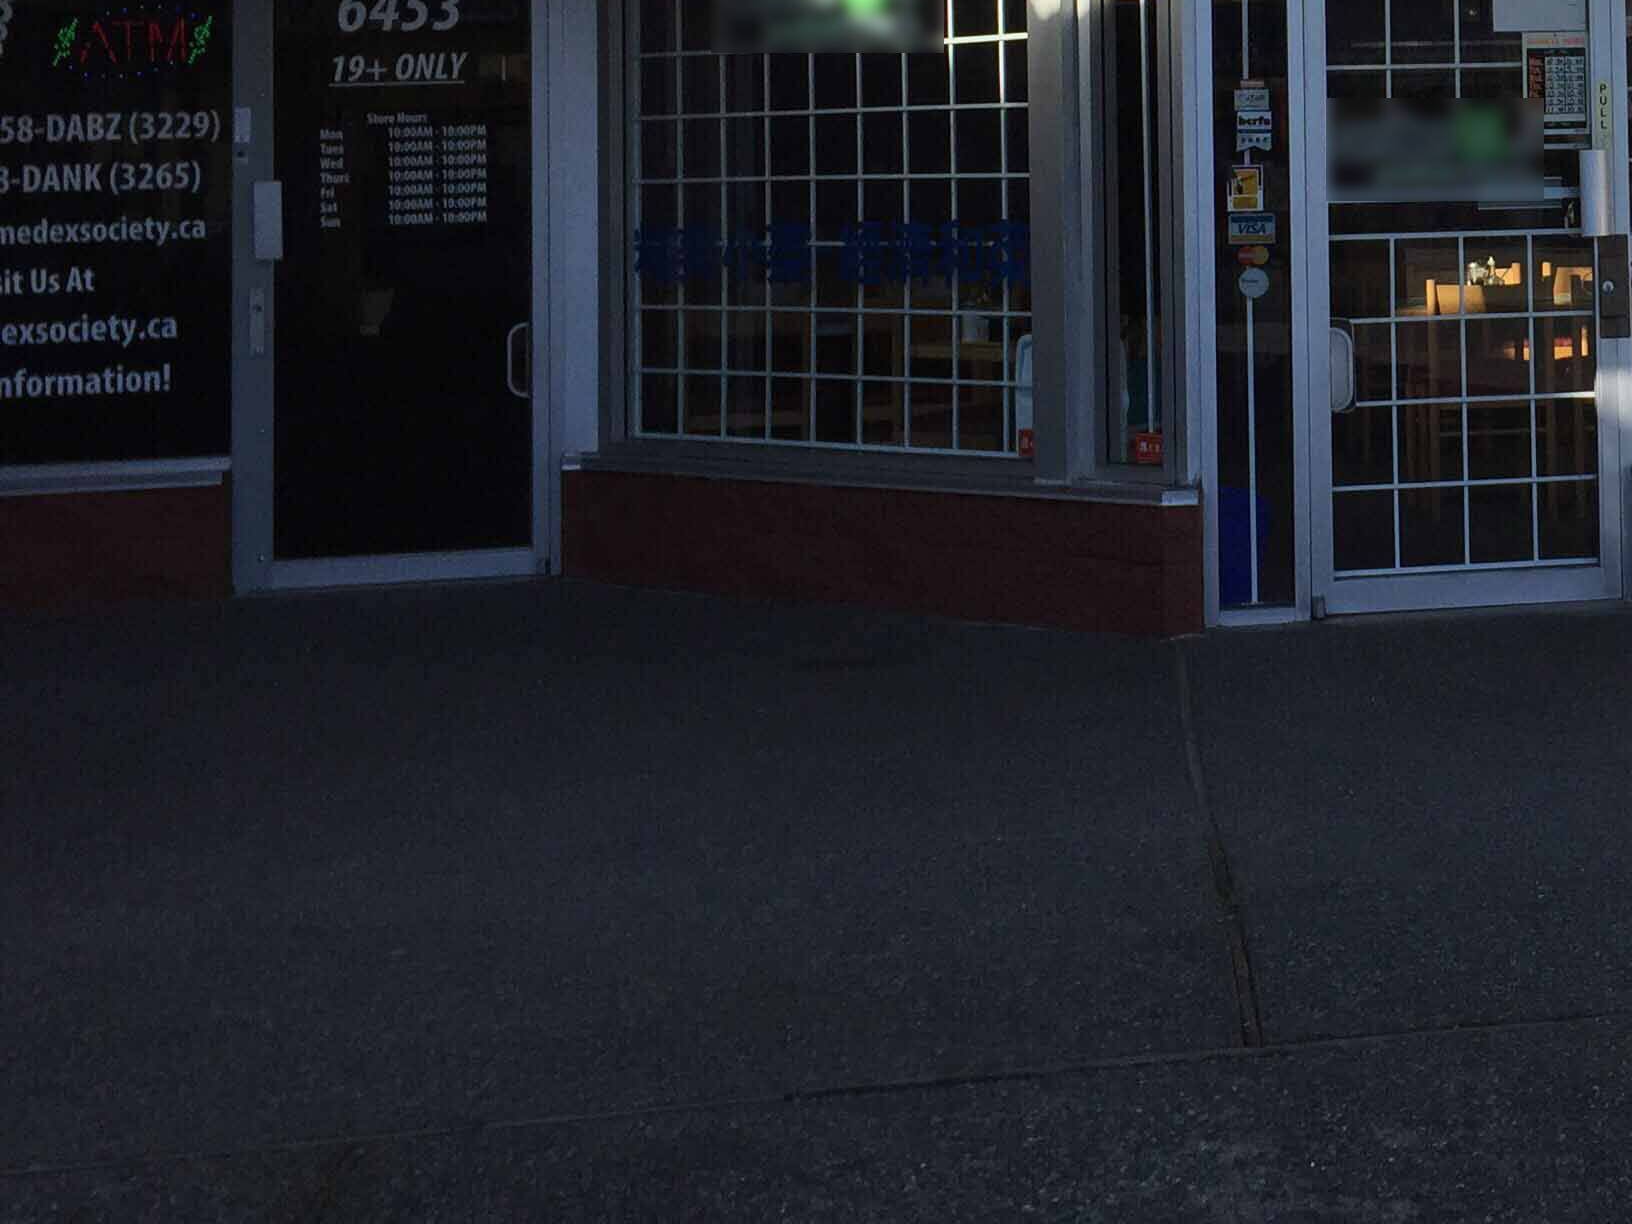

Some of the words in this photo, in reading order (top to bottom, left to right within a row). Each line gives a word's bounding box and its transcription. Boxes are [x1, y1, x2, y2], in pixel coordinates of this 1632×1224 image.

[332, 54, 390, 82] 19+
[394, 51, 469, 81] ONLY
[129, 110, 221, 144] (3229)
[110, 160, 201, 195] (3265)
[1238, 223, 1266, 234] VISA
[0, 267, 24, 295] it
[29, 267, 60, 296] Us
[66, 265, 96, 294] At
[0, 313, 178, 350] exsociety.ca
